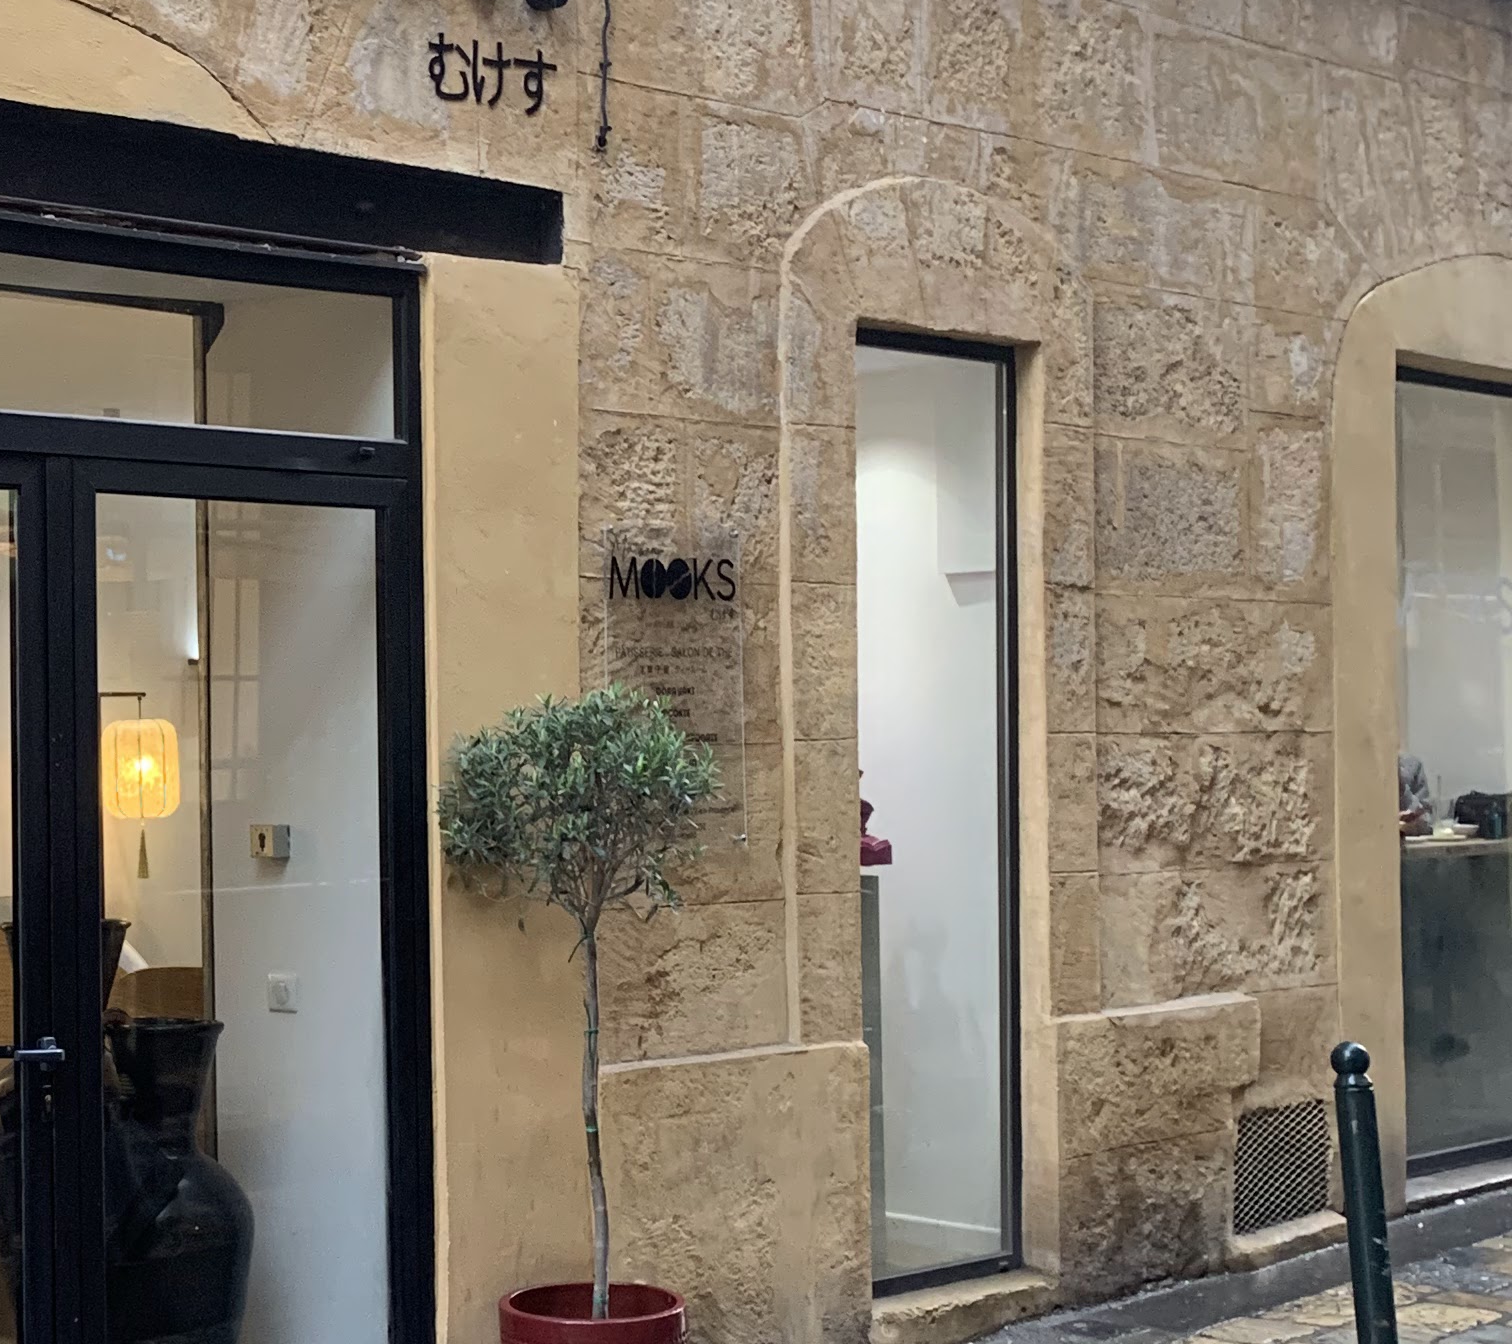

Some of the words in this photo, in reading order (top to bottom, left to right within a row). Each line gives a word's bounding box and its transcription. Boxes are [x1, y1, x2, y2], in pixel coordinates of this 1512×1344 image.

[428, 32, 557, 116] むけす
[609, 555, 737, 601] MOOKS
